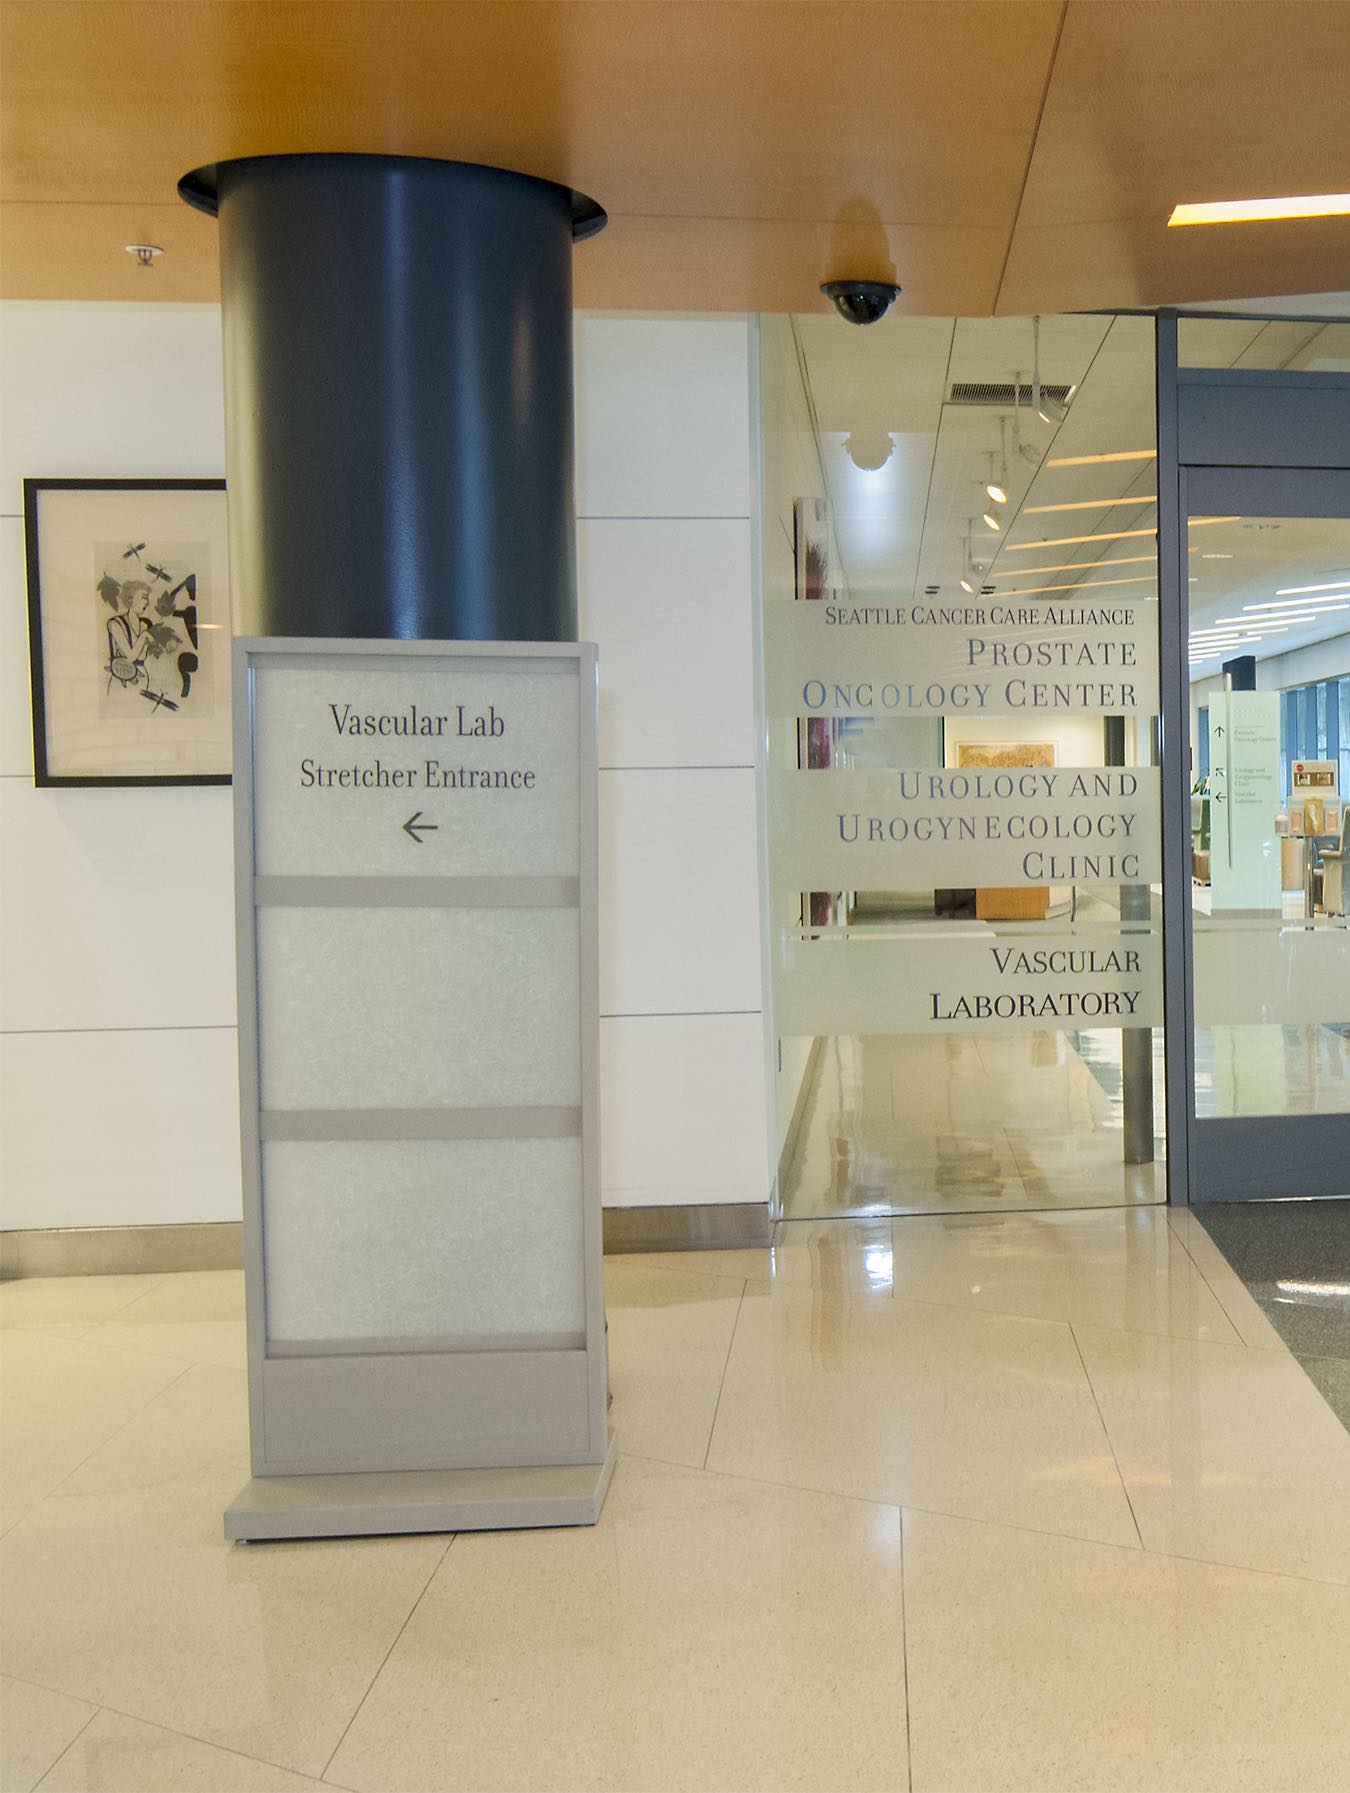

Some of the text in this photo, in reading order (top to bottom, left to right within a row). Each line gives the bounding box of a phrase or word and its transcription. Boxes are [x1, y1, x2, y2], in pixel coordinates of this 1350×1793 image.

[825, 606, 1135, 626] SEATTLE CANCER CARE ALLIANCE
[965, 638, 1137, 667] PROSTATE
[802, 679, 1138, 710] ONCOLOGY CENTER
[328, 703, 505, 738] Vascular Lab
[300, 758, 537, 790] Stretcher Entrance
[899, 771, 1138, 801] UROLOGY AND
[837, 813, 1138, 842] UROGYNECOLOGY
[1022, 851, 1140, 880] CLINIC
[990, 947, 1142, 975] VASCULAR
[929, 990, 1142, 1021] LABORATORY
